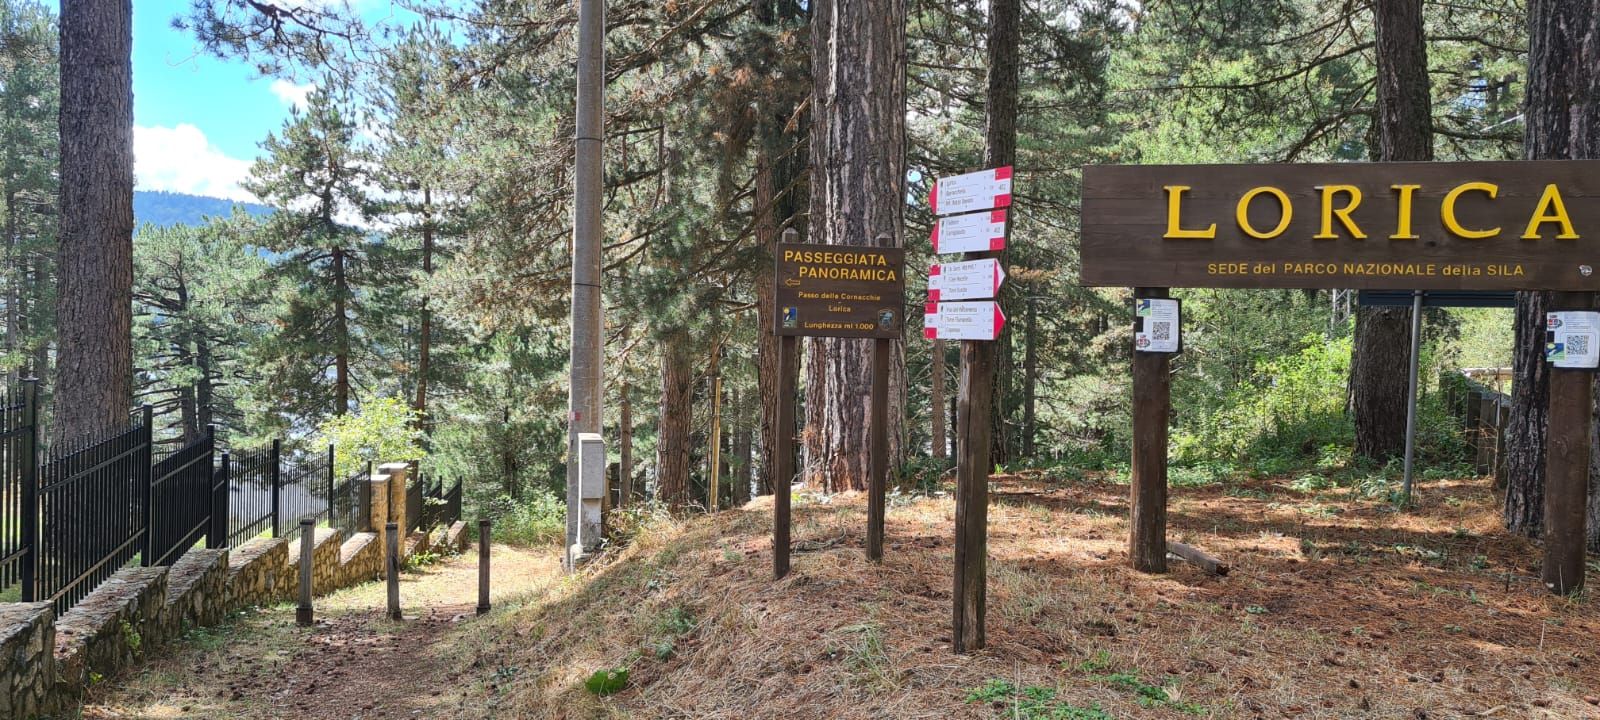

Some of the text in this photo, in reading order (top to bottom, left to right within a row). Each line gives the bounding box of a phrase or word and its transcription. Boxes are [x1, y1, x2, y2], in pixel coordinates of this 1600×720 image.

[1163, 182, 1579, 239] LORICA
[784, 250, 887, 266] PASSEGGIATA
[799, 266, 897, 281] PANORAMICA
[1207, 263, 1249, 275] SEDE
[1253, 263, 1276, 274] del
[1284, 263, 1337, 275] PARCO
[1343, 263, 1437, 276] NAZIONALE
[1487, 264, 1524, 276] SILA
[798, 291, 819, 299] Passo
[828, 304, 851, 313] Lorica
[804, 321, 842, 330] Lunghezza
